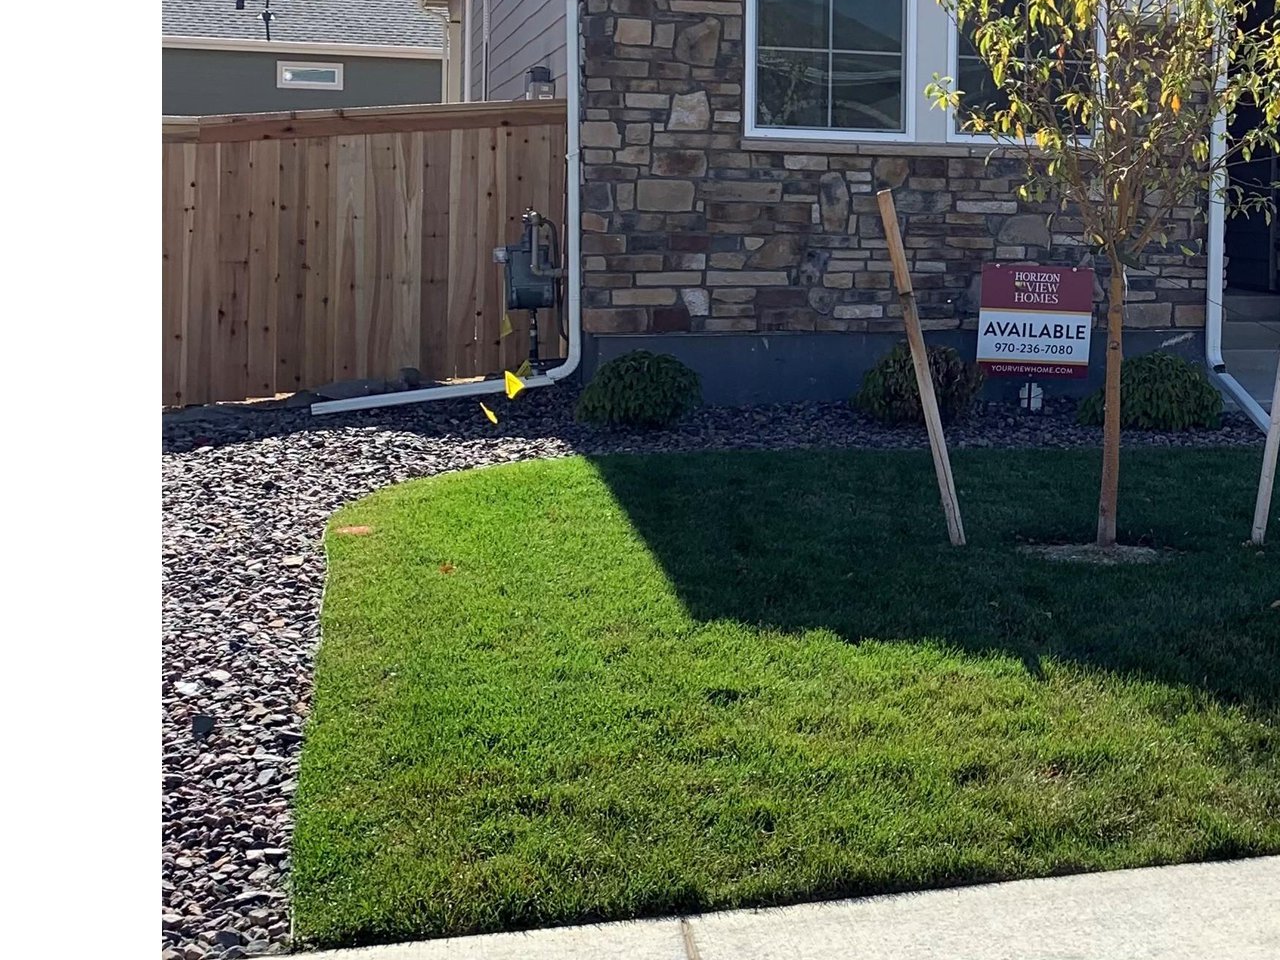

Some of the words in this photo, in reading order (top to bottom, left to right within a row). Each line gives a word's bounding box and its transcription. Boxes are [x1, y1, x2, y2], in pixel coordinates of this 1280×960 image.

[1015, 271, 1060, 283] HORIZON
[1026, 282, 1060, 293] VIEW
[1014, 292, 1059, 304] HOMES
[983, 321, 1086, 340] AVAILABLE
[994, 342, 1074, 355] 970-236-7080
[991, 364, 1073, 375] YOURVIEWHOME.COM
